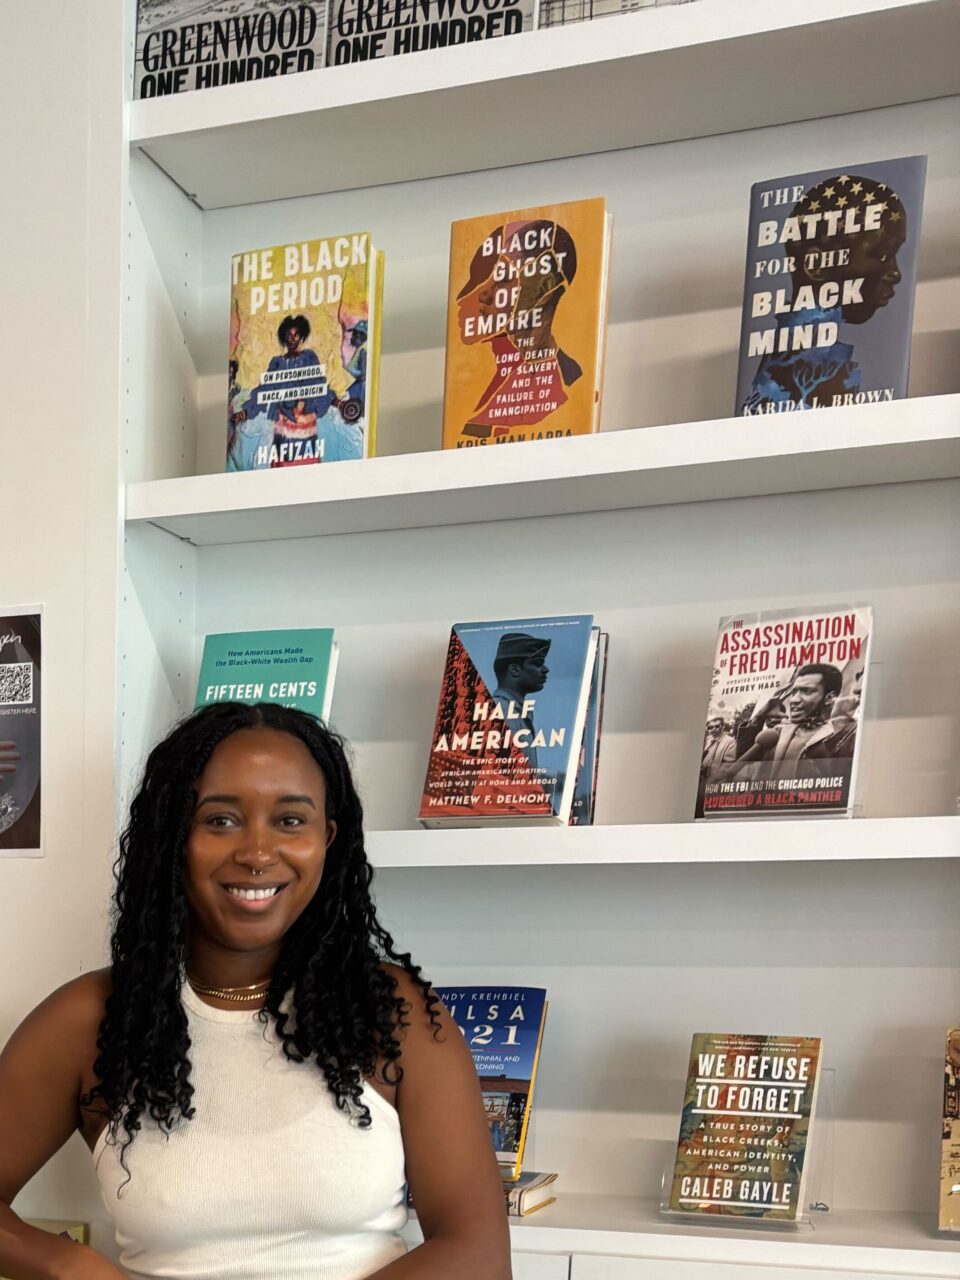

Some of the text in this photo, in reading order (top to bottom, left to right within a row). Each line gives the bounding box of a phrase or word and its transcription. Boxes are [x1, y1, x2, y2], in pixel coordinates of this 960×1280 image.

[143, 5, 317, 72] GREENWOOD
[336, 10, 522, 65] ONE HUNDRED
[141, 49, 314, 98] ONE HUNDRED
[761, 185, 804, 209] THE
[758, 203, 882, 247] BATTLE
[482, 228, 552, 256] BLACK
[233, 233, 367, 285] THE BLACK
[493, 252, 567, 281] GHOST
[755, 248, 850, 279] FOR THE
[250, 274, 343, 315] PERIOD
[495, 286, 521, 308] OF
[752, 278, 864, 318] BLACK
[464, 308, 543, 337] EMPIRE
[518, 337, 534, 346] THE
[748, 322, 838, 357] MIND
[496, 349, 556, 364] LONG DEATH
[264, 374, 273, 382] ON
[501, 361, 557, 377] OF SLAVERY
[284, 390, 298, 399] AND
[299, 386, 323, 397] ORIGIN
[512, 376, 553, 388] AND THE
[496, 389, 550, 403] FAILURE OF
[743, 398, 805, 417] KARIDA
[832, 388, 895, 408] BROWN
[489, 402, 557, 418] EMANCIPATION
[258, 439, 325, 465] HAFIZAH
[720, 614, 856, 654] ASSASSINATION
[733, 620, 744, 629] THE
[229, 658, 271, 666] Black-White
[299, 656, 313, 664] Gap
[245, 648, 282, 656] Americans
[720, 638, 861, 676] OF FRED HAMPTON
[206, 682, 316, 700] FIFTEEN CENTS
[722, 681, 780, 695] JEFFREY HAAS
[473, 700, 536, 721] HALF
[434, 728, 565, 752] AMERICAN
[429, 780, 452, 788] WORLD
[705, 777, 843, 793] HOW THE FBI AND THE CHICAGO POLICE
[429, 794, 551, 806] MATTHEW F. DELMONT
[704, 790, 842, 808] MURDERED A BLACK PANTHER
[472, 993, 526, 1001] KREHBIEL
[699, 1054, 810, 1080] WE REFUSE
[696, 1085, 804, 1112] TO FORGET
[710, 1122, 735, 1131] TRUE
[740, 1124, 772, 1132] STORY
[777, 1126, 790, 1134] OF
[703, 1136, 783, 1148] BLACK CREEKS,
[686, 1148, 796, 1163] AMERICAN IDENTITY,
[734, 1164, 769, 1173] POWER
[681, 1177, 791, 1202] CALEB GAYLE
